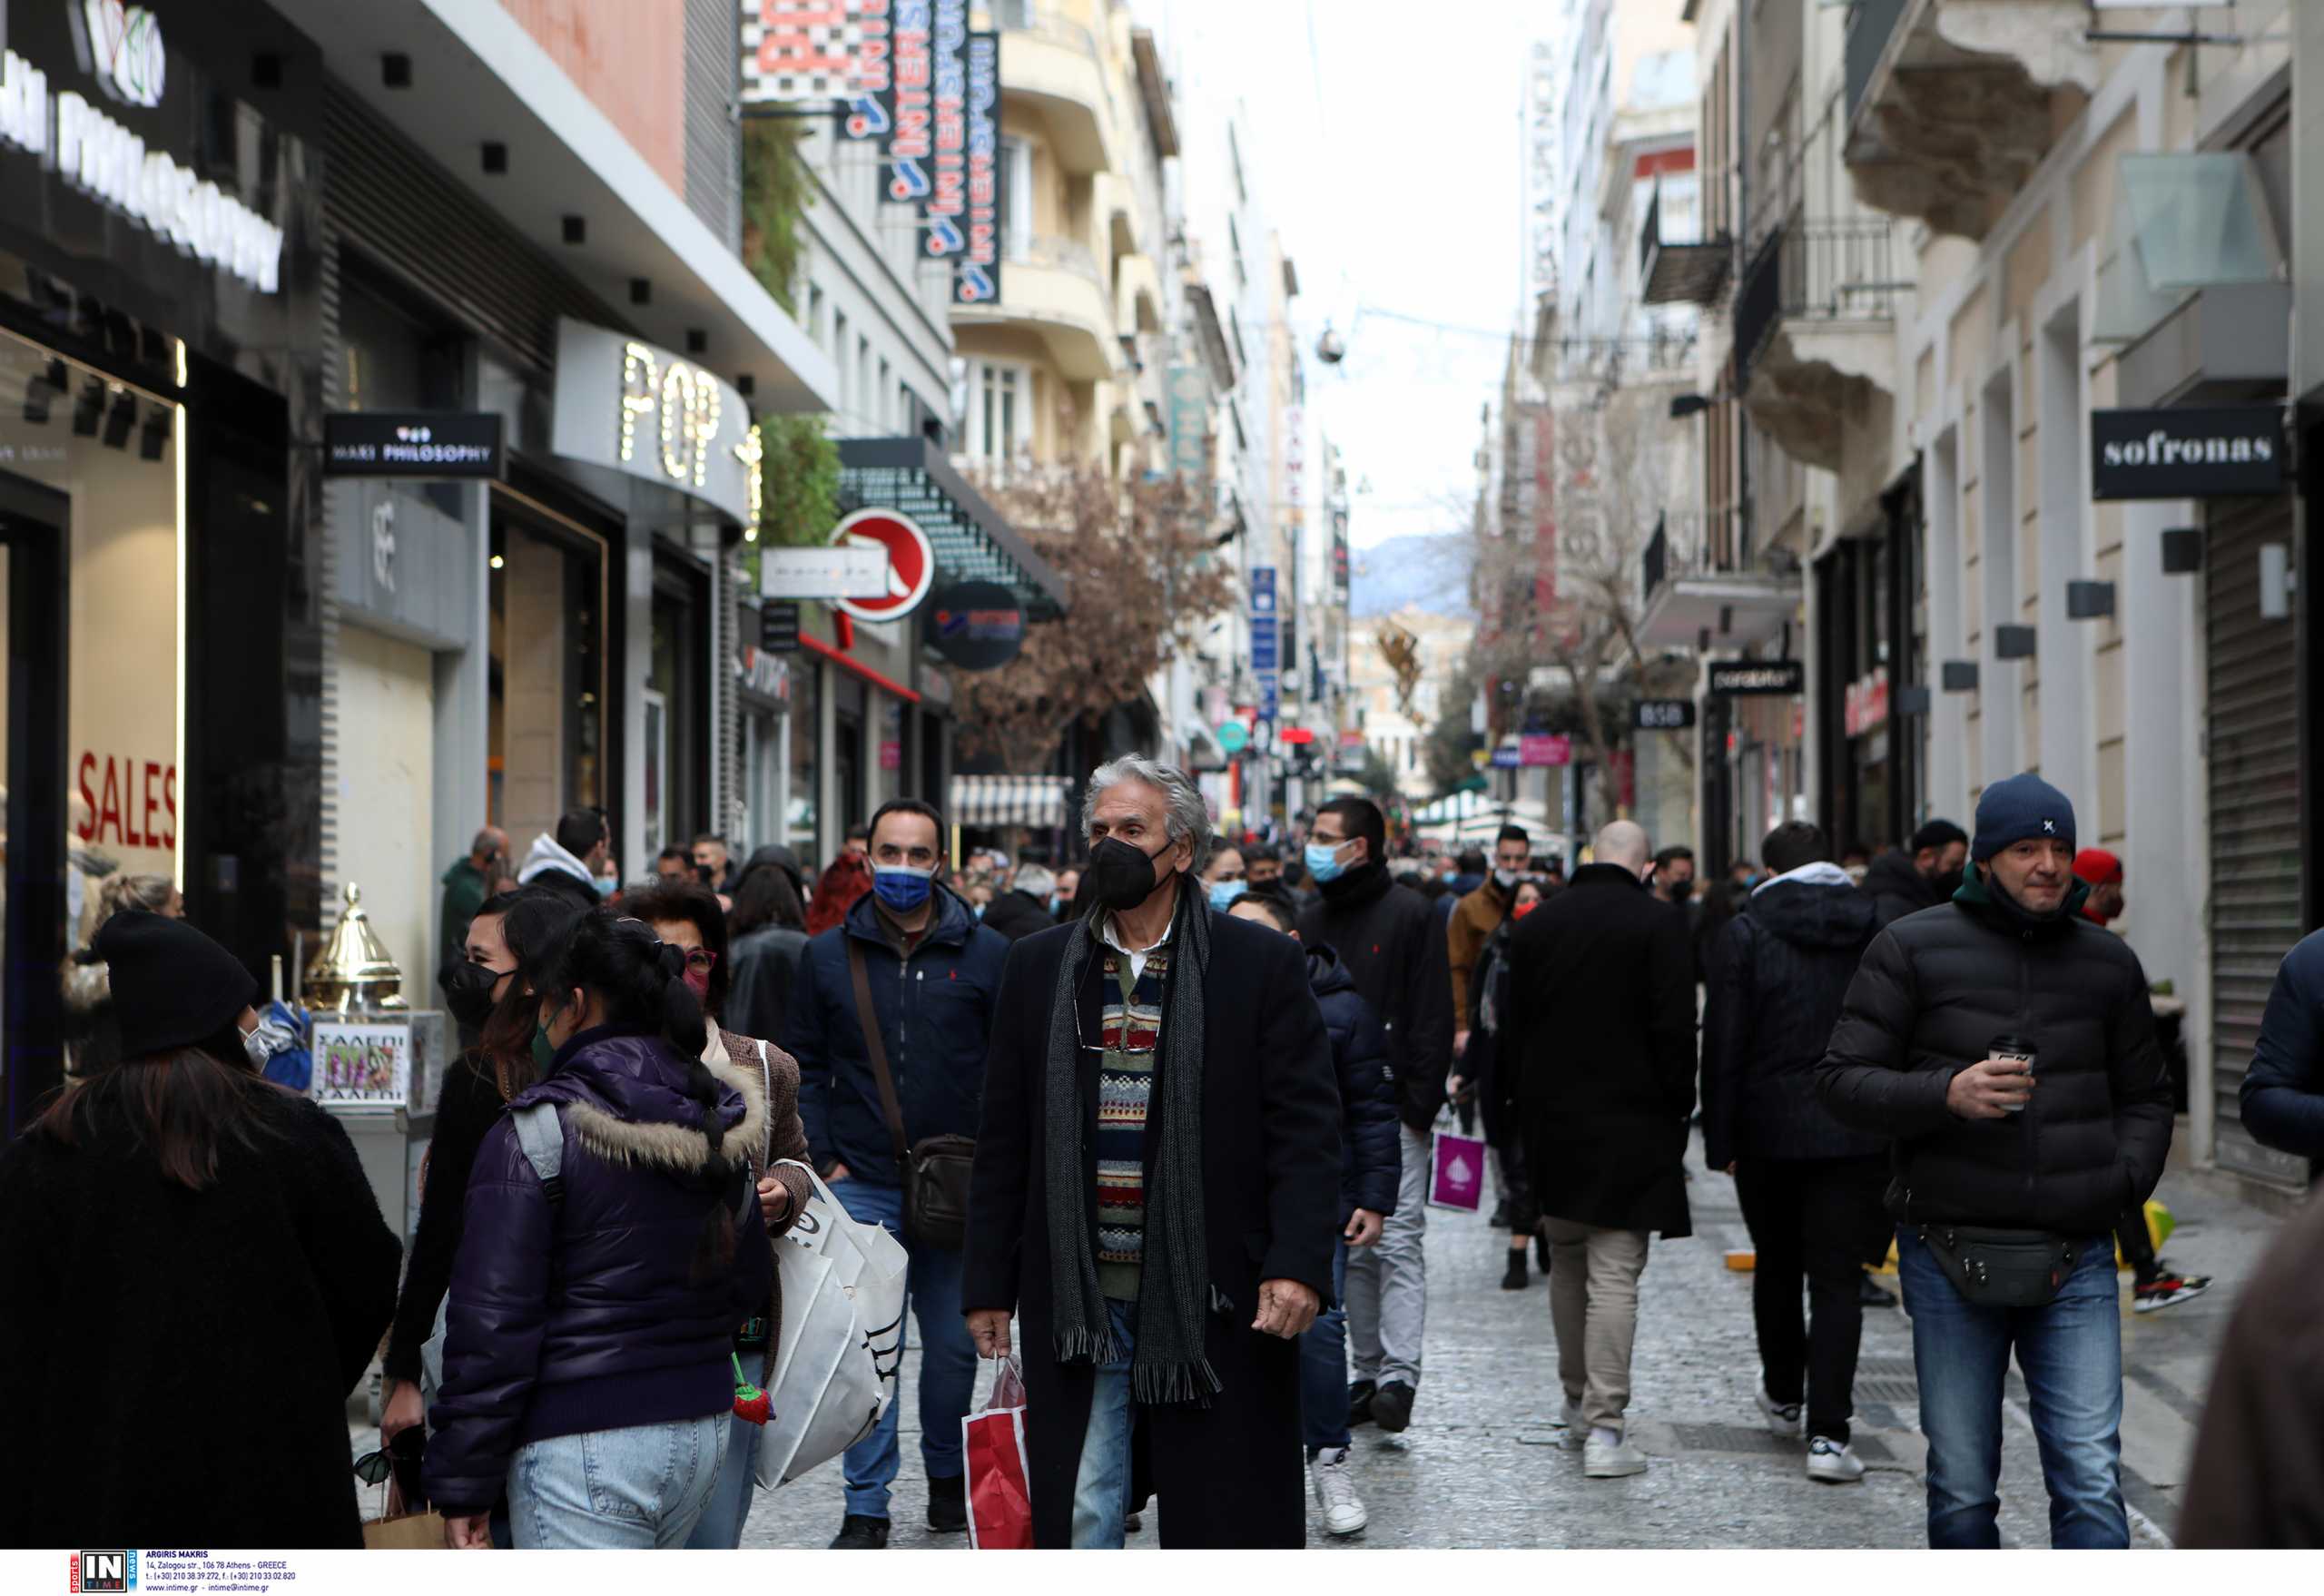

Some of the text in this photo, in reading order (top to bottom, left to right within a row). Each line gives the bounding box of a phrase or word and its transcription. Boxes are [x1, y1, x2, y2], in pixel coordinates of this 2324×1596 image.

[968, 38, 996, 263] INTERSPORT
[621, 341, 721, 488] POP
[2103, 430, 2272, 466] sofronas
[382, 443, 491, 462] PHILOSOPHY
[78, 751, 176, 850] SALES
[319, 1035, 403, 1047] ΣΑΛΕΠΙ
